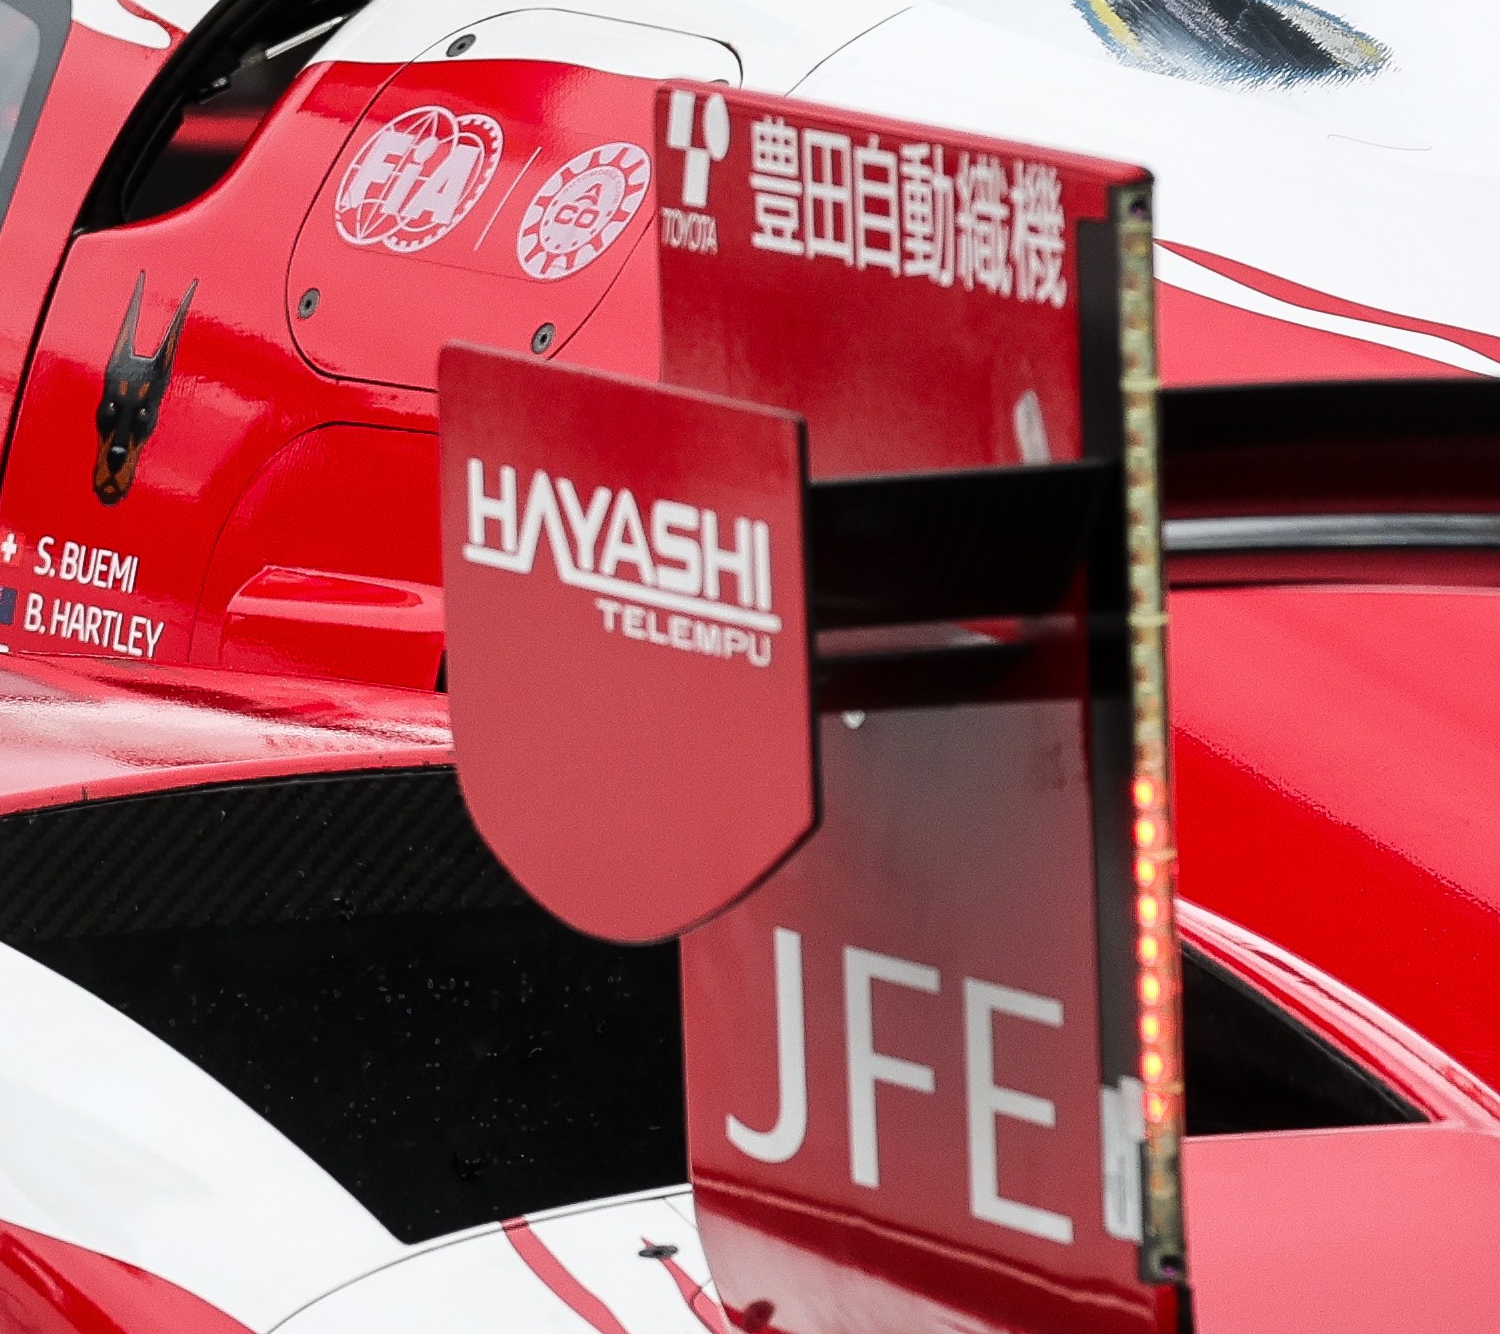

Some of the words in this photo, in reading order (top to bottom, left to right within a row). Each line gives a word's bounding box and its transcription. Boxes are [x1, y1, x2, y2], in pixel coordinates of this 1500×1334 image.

[661, 207, 719, 256] TOYOTA
[750, 115, 1069, 309] 豊田自動織機
[33, 536, 56, 578] S.
[58, 541, 139, 594] BUEMI
[466, 456, 771, 613] HAYASHI
[23, 592, 46, 634] B.
[49, 598, 166, 659] HARTLEY
[595, 598, 772, 667] TELEMPU
[724, 925, 1075, 1246] JFE
